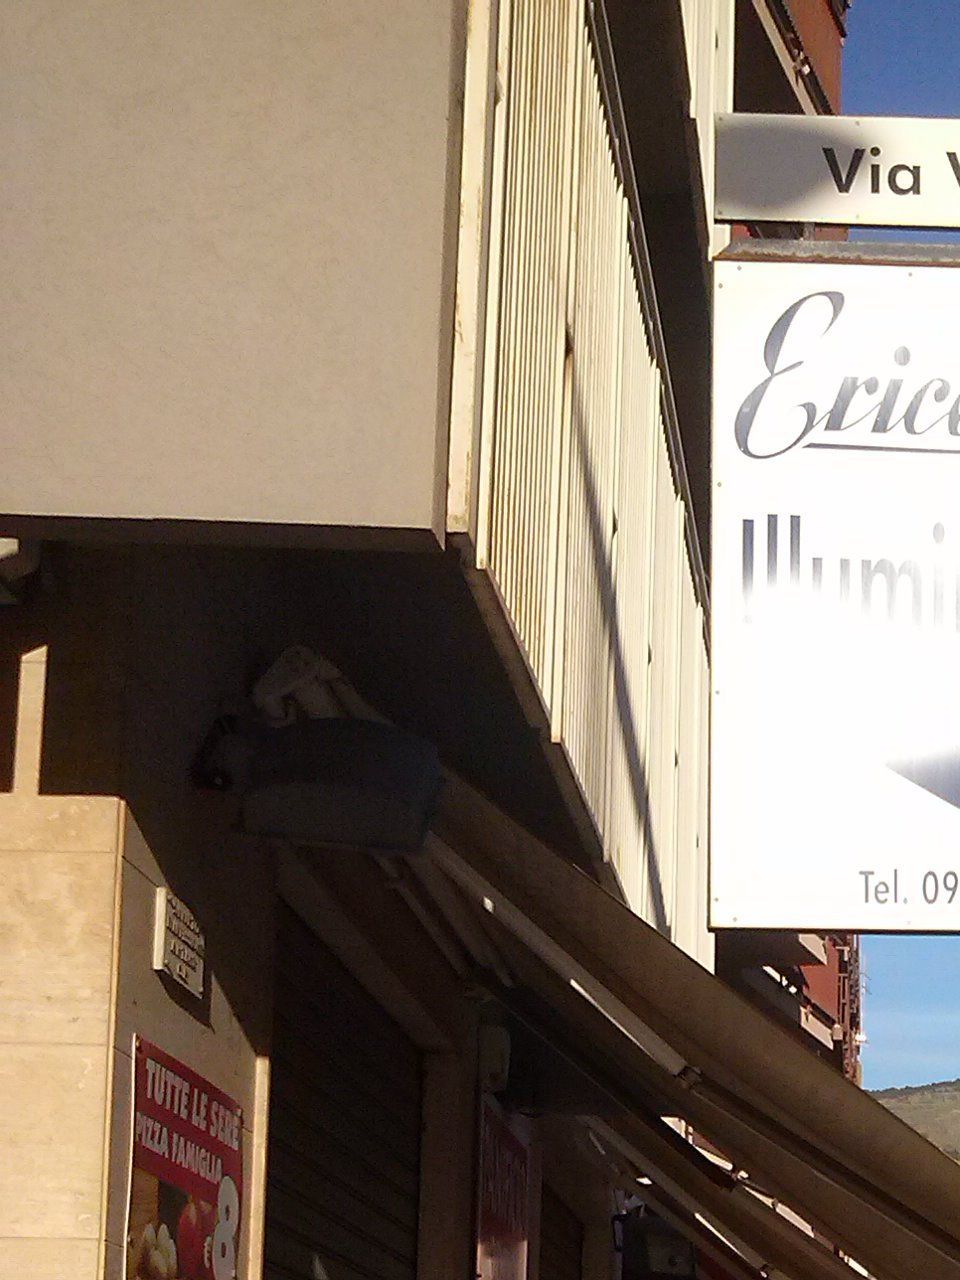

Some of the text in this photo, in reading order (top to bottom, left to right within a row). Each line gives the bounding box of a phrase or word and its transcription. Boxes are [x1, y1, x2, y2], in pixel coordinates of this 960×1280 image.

[821, 146, 921, 196] Via
[858, 868, 909, 906] Tel.
[146, 1057, 190, 1120] TUTTE
[191, 1087, 209, 1132] LE
[135, 1111, 223, 1185] PIZZA FAMIGLIA
